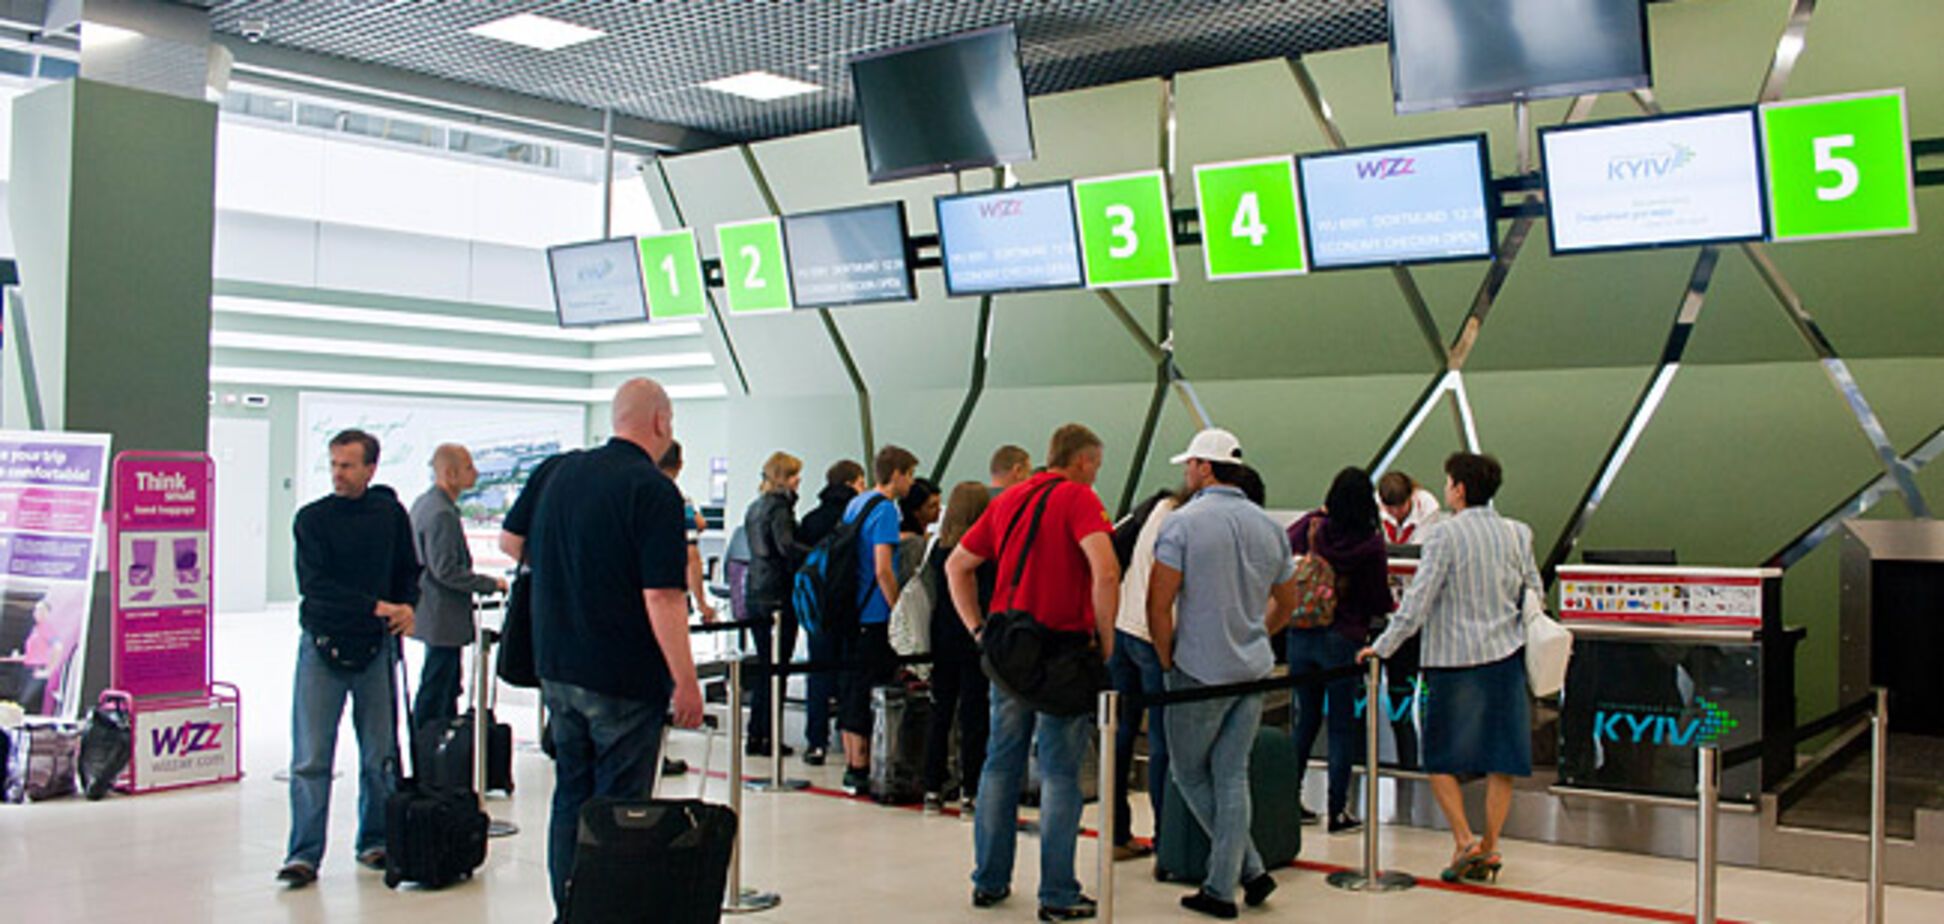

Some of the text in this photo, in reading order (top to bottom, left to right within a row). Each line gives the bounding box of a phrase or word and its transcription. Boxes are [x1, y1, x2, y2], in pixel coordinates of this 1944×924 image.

[1608, 156, 1671, 181] KYIV
[1811, 134, 1860, 201] 5
[1105, 204, 1139, 259] 3
[1231, 191, 1267, 246] 4
[659, 254, 681, 297] 1
[739, 244, 766, 288] 2
[11, 450, 40, 464] your
[43, 448, 67, 467] trip
[8, 465, 91, 482] comfortable!
[135, 471, 187, 492] Think
[164, 489, 196, 501] small
[1594, 710, 1701, 745] KYIV
[151, 753, 225, 773] wizzair.com
